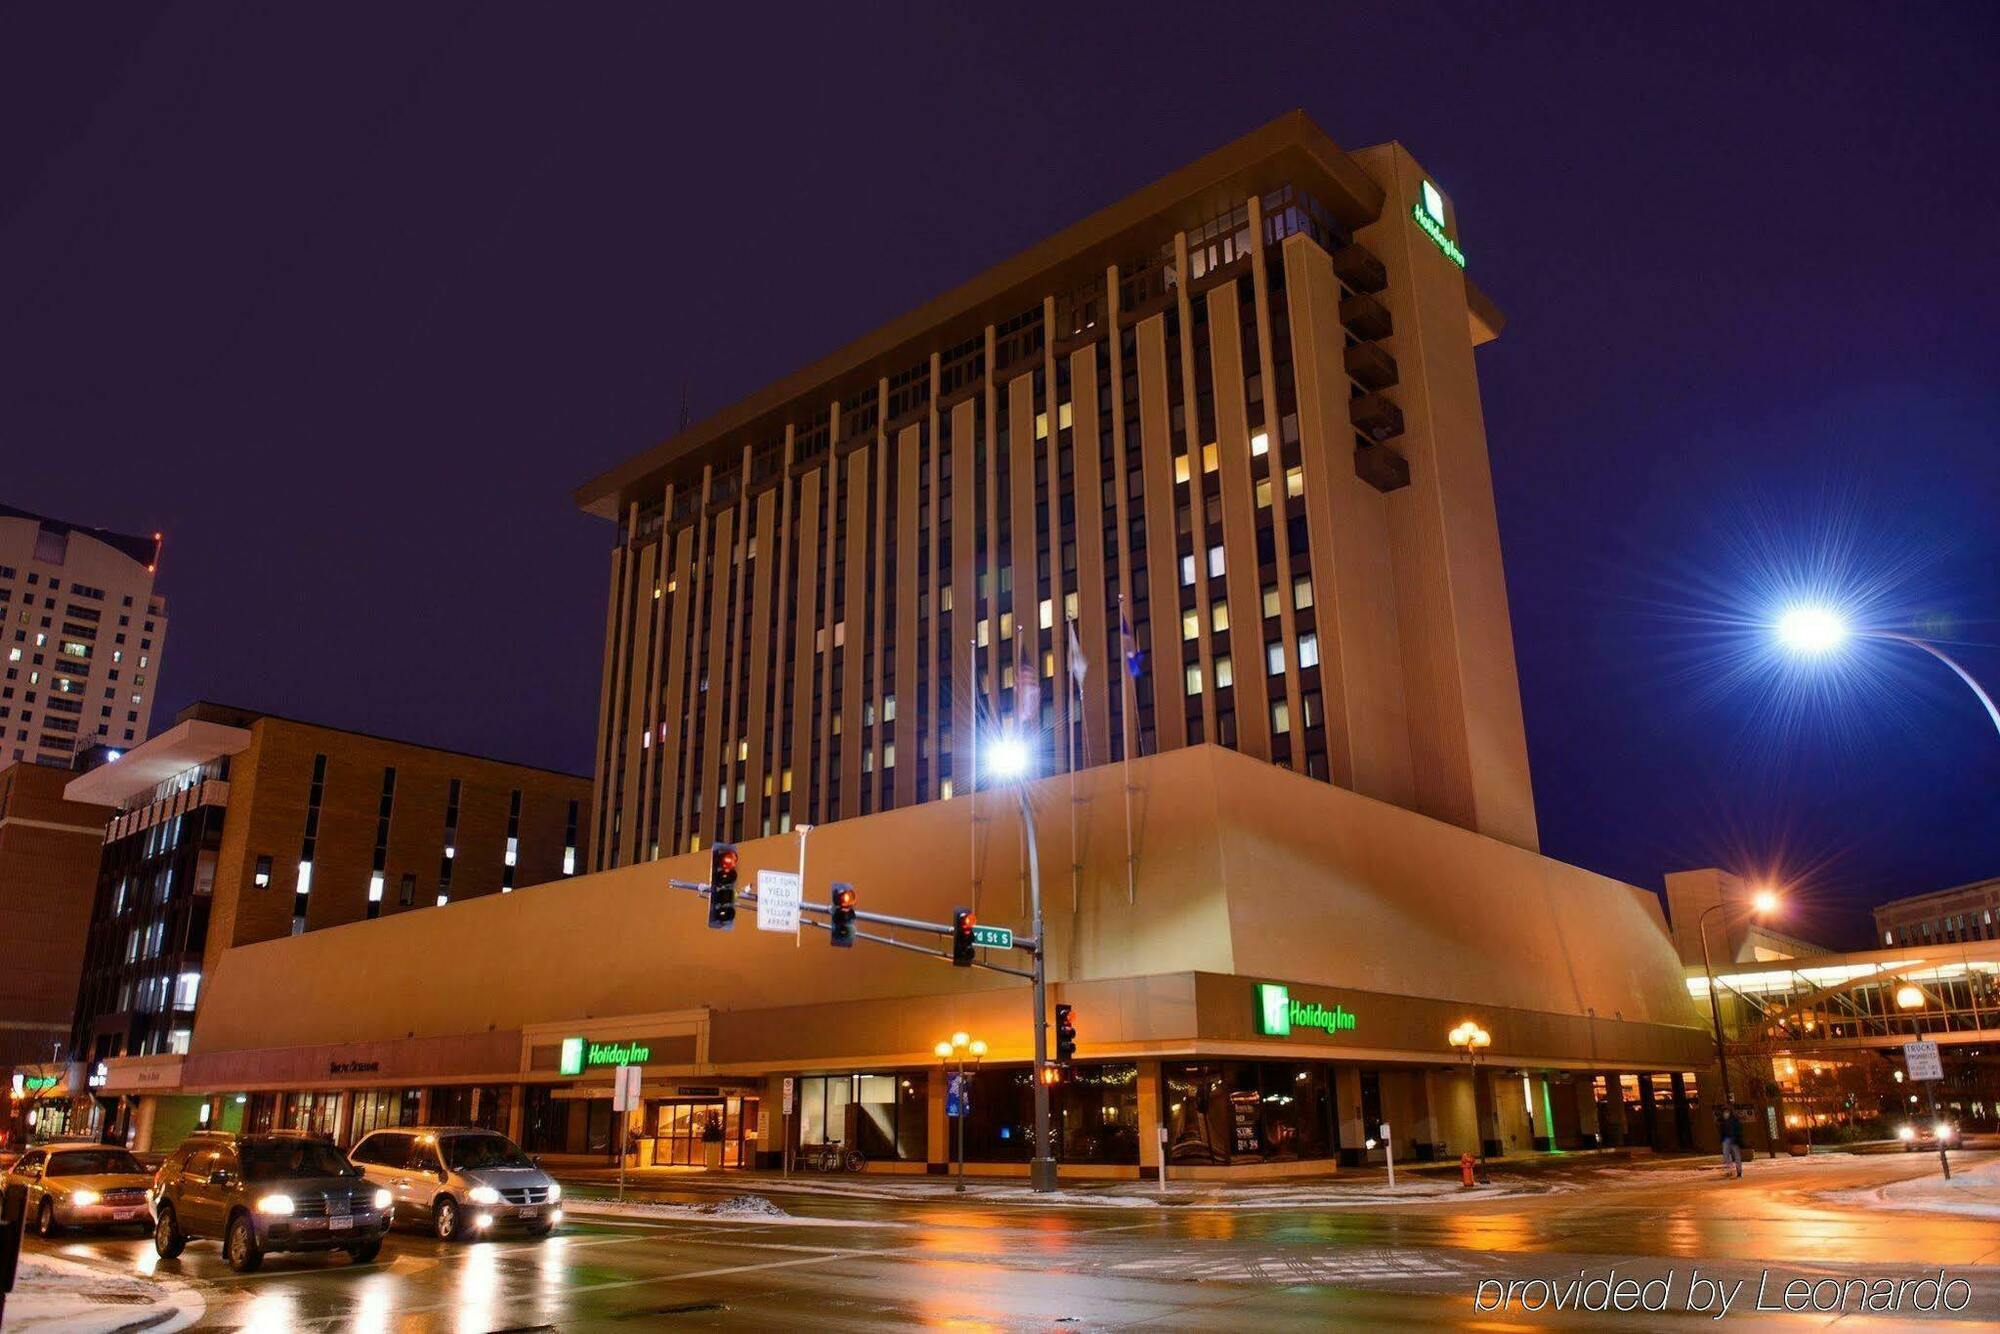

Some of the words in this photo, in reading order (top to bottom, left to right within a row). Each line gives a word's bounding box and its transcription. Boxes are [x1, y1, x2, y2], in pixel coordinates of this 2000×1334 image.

[1413, 203, 1451, 256] Holiday
[768, 887, 791, 898] YIELD
[987, 931, 998, 943] St
[1001, 933, 1008, 944] S
[1290, 999, 1336, 1033] Holiday
[1337, 1004, 1355, 1030] Inn
[588, 1043, 631, 1067] Holiday
[630, 1042, 649, 1062] Inn
[1906, 1043, 1936, 1052] TRUCKS
